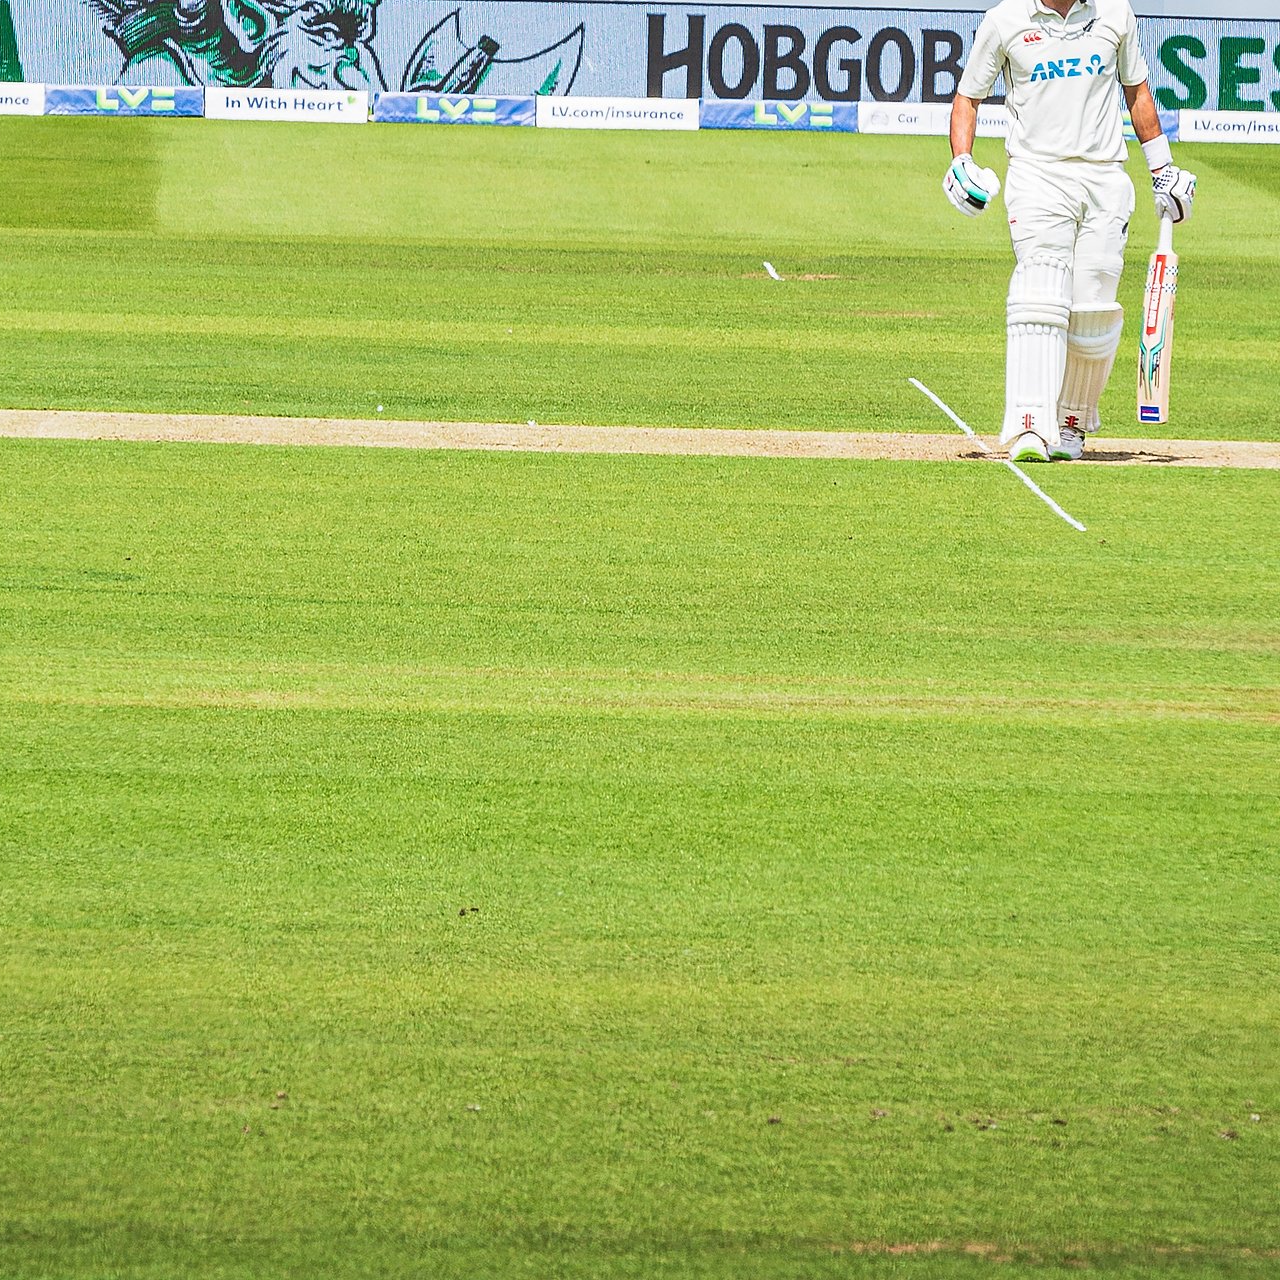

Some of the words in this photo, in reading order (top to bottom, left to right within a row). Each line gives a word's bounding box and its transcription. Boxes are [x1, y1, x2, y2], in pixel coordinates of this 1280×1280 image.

[1029, 57, 1081, 82] ANZ
[225, 97, 240, 109] In
[245, 97, 287, 110] With
[293, 99, 343, 112] Heart
[551, 105, 684, 121] LV.com/insurance
[897, 113, 918, 124] Car
